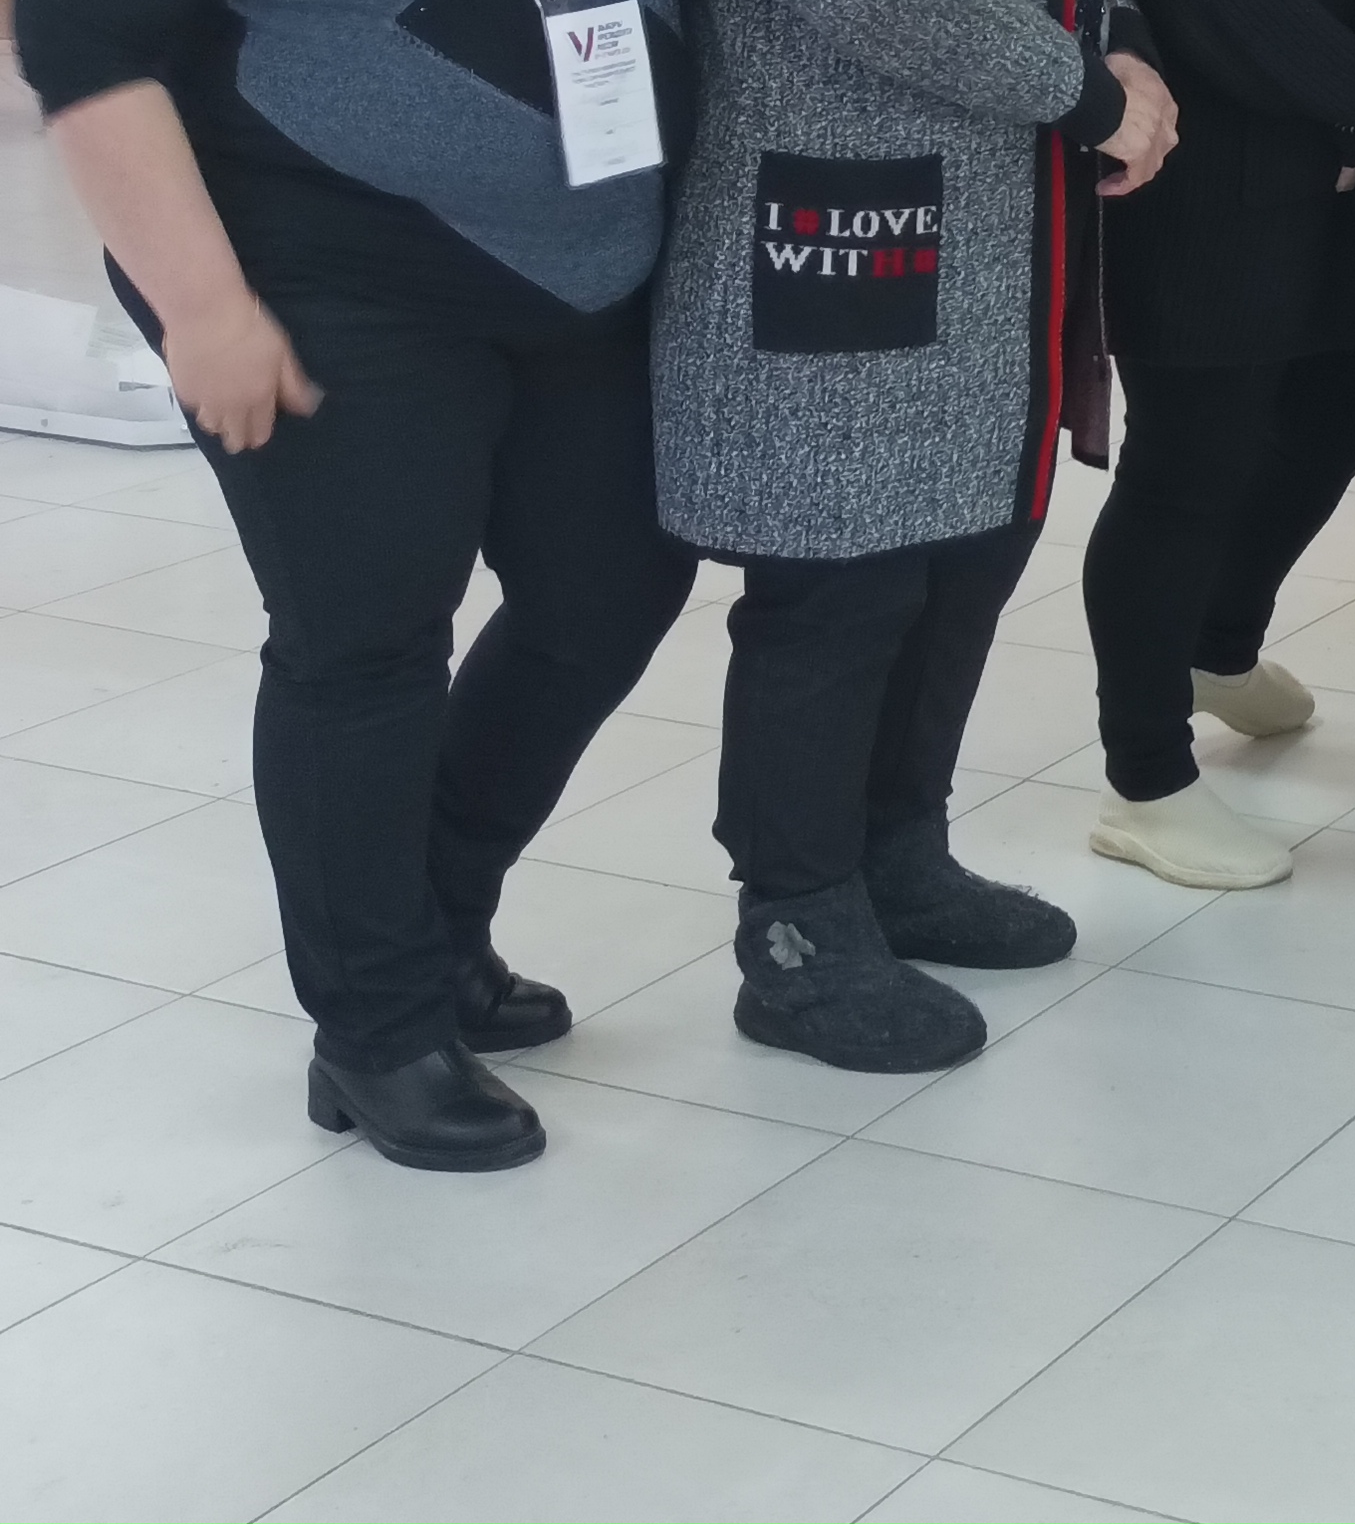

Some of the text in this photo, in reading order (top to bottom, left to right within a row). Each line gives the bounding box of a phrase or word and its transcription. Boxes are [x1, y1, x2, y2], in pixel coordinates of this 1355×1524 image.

[764, 202, 937, 238] I LOVE
[760, 241, 905, 277] WITH
